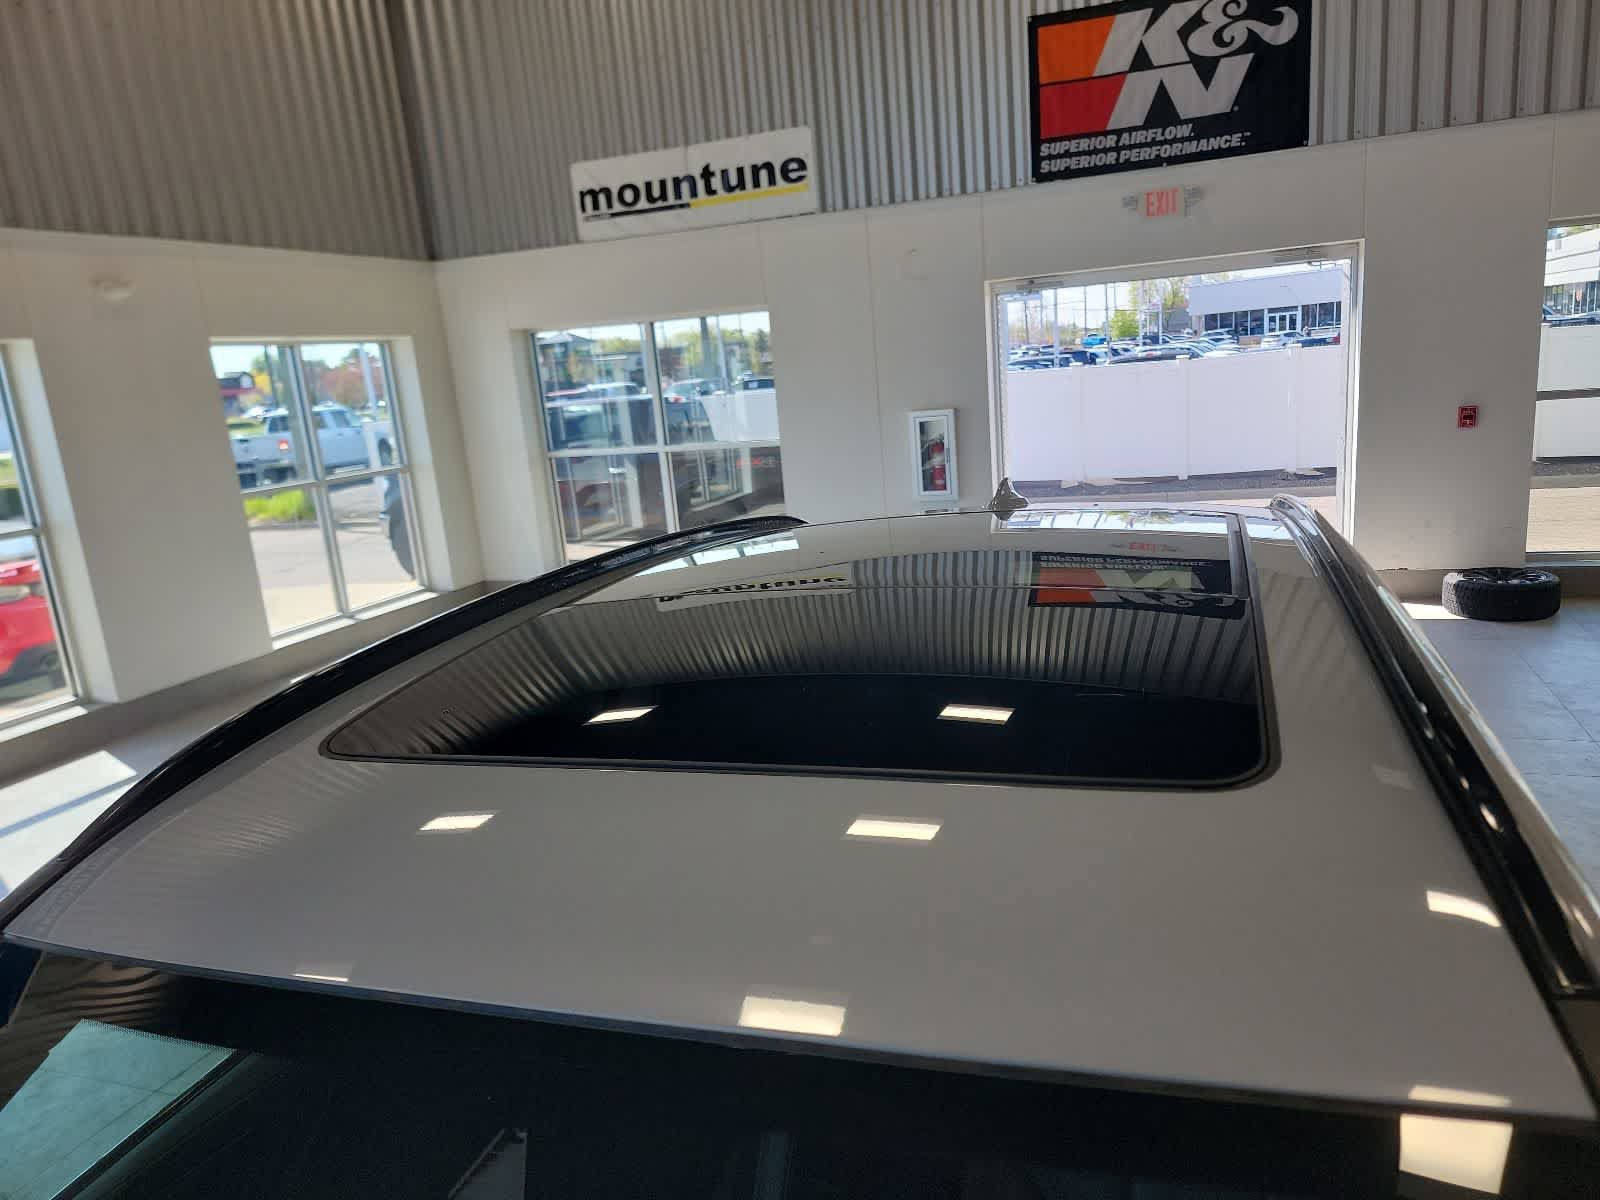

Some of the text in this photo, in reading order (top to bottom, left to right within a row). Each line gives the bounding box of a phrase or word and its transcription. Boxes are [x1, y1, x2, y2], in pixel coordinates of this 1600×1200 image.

[1040, 123, 1195, 157] SUPERIOR AIRFLOW.
[1040, 152, 1118, 173] SUPERIOR
[579, 156, 808, 214] mountune
[1145, 188, 1179, 217] EXIT
